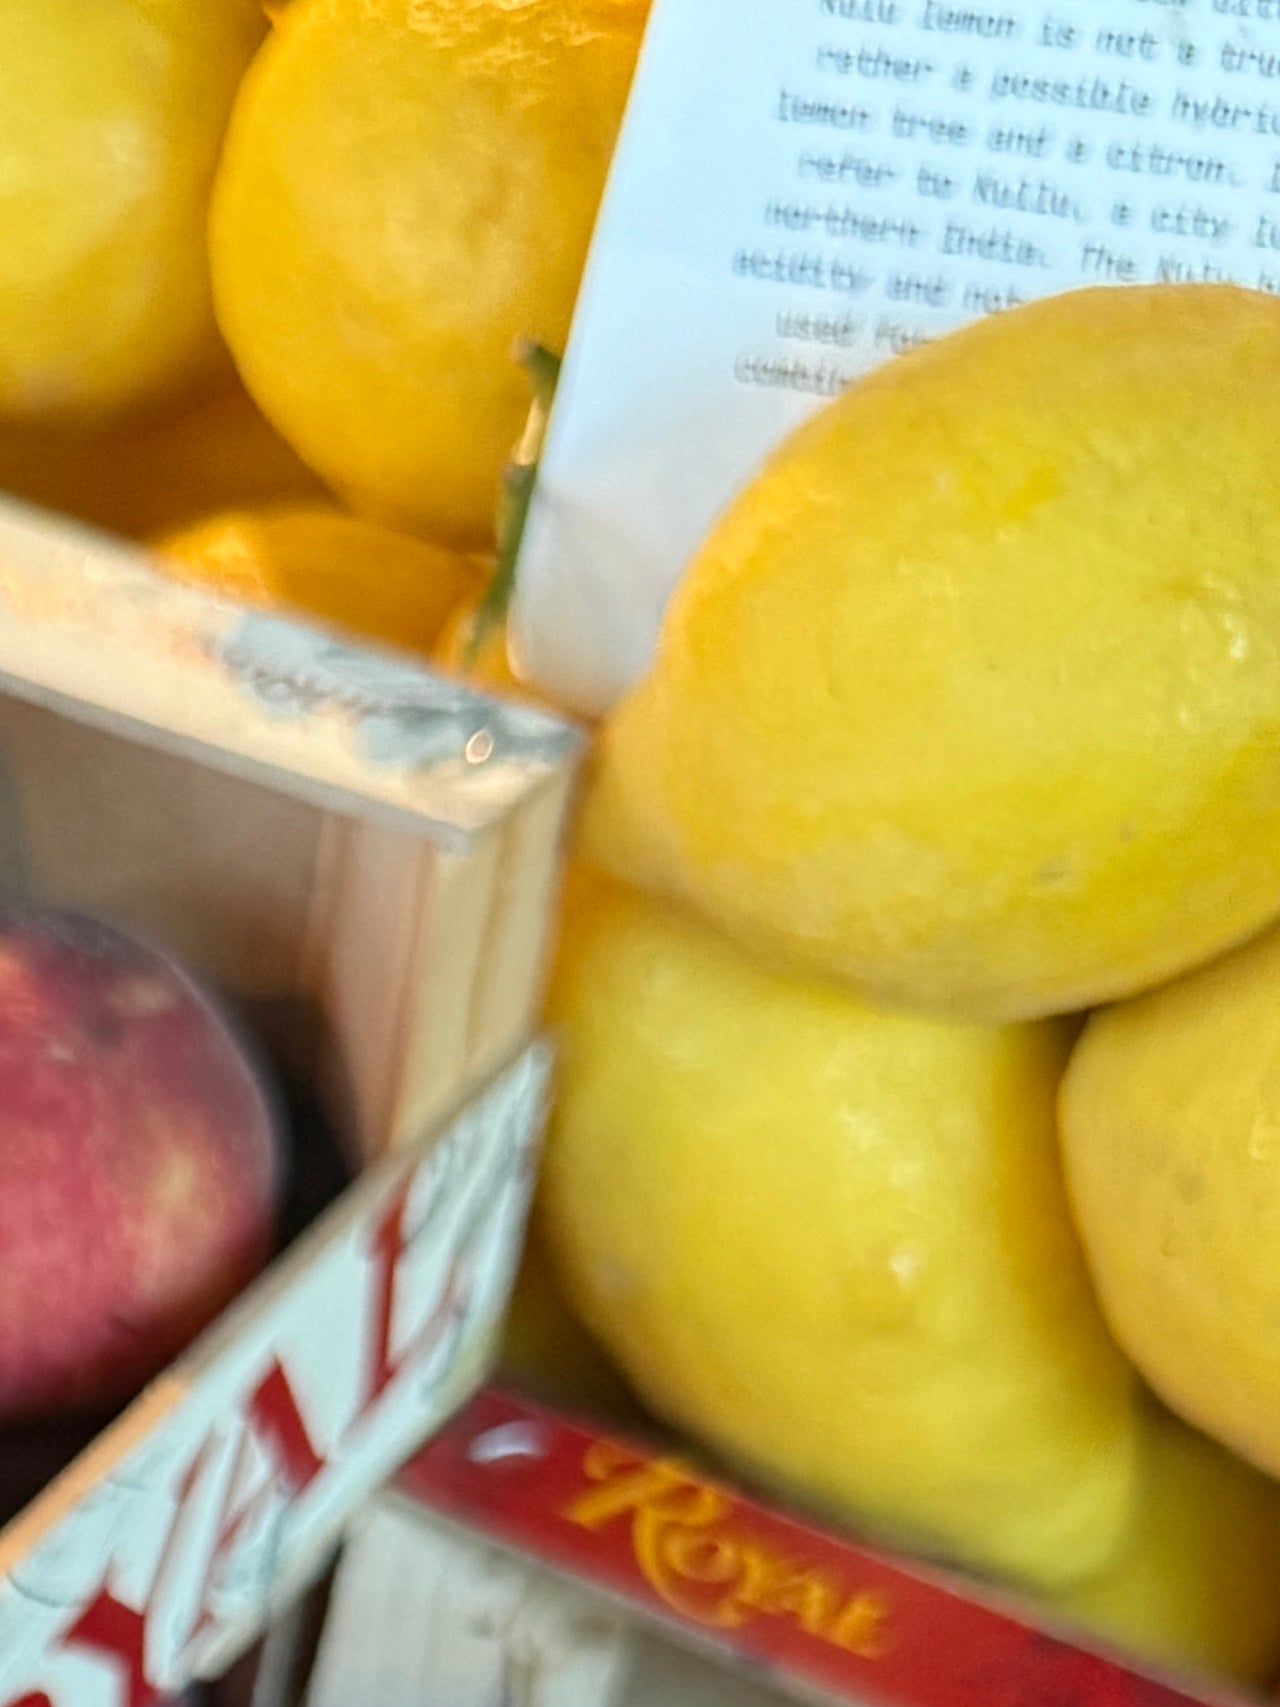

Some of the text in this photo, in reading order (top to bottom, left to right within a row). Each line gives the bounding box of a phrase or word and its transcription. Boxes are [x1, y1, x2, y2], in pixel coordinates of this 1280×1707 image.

[1040, 20, 1077, 49] is
[1095, 27, 1159, 60] not
[816, 46, 934, 83] rather
[990, 74, 1152, 116] possible
[777, 89, 870, 130] lemon
[893, 106, 970, 144] tree
[796, 150, 898, 188] refer
[764, 200, 920, 246] northern
